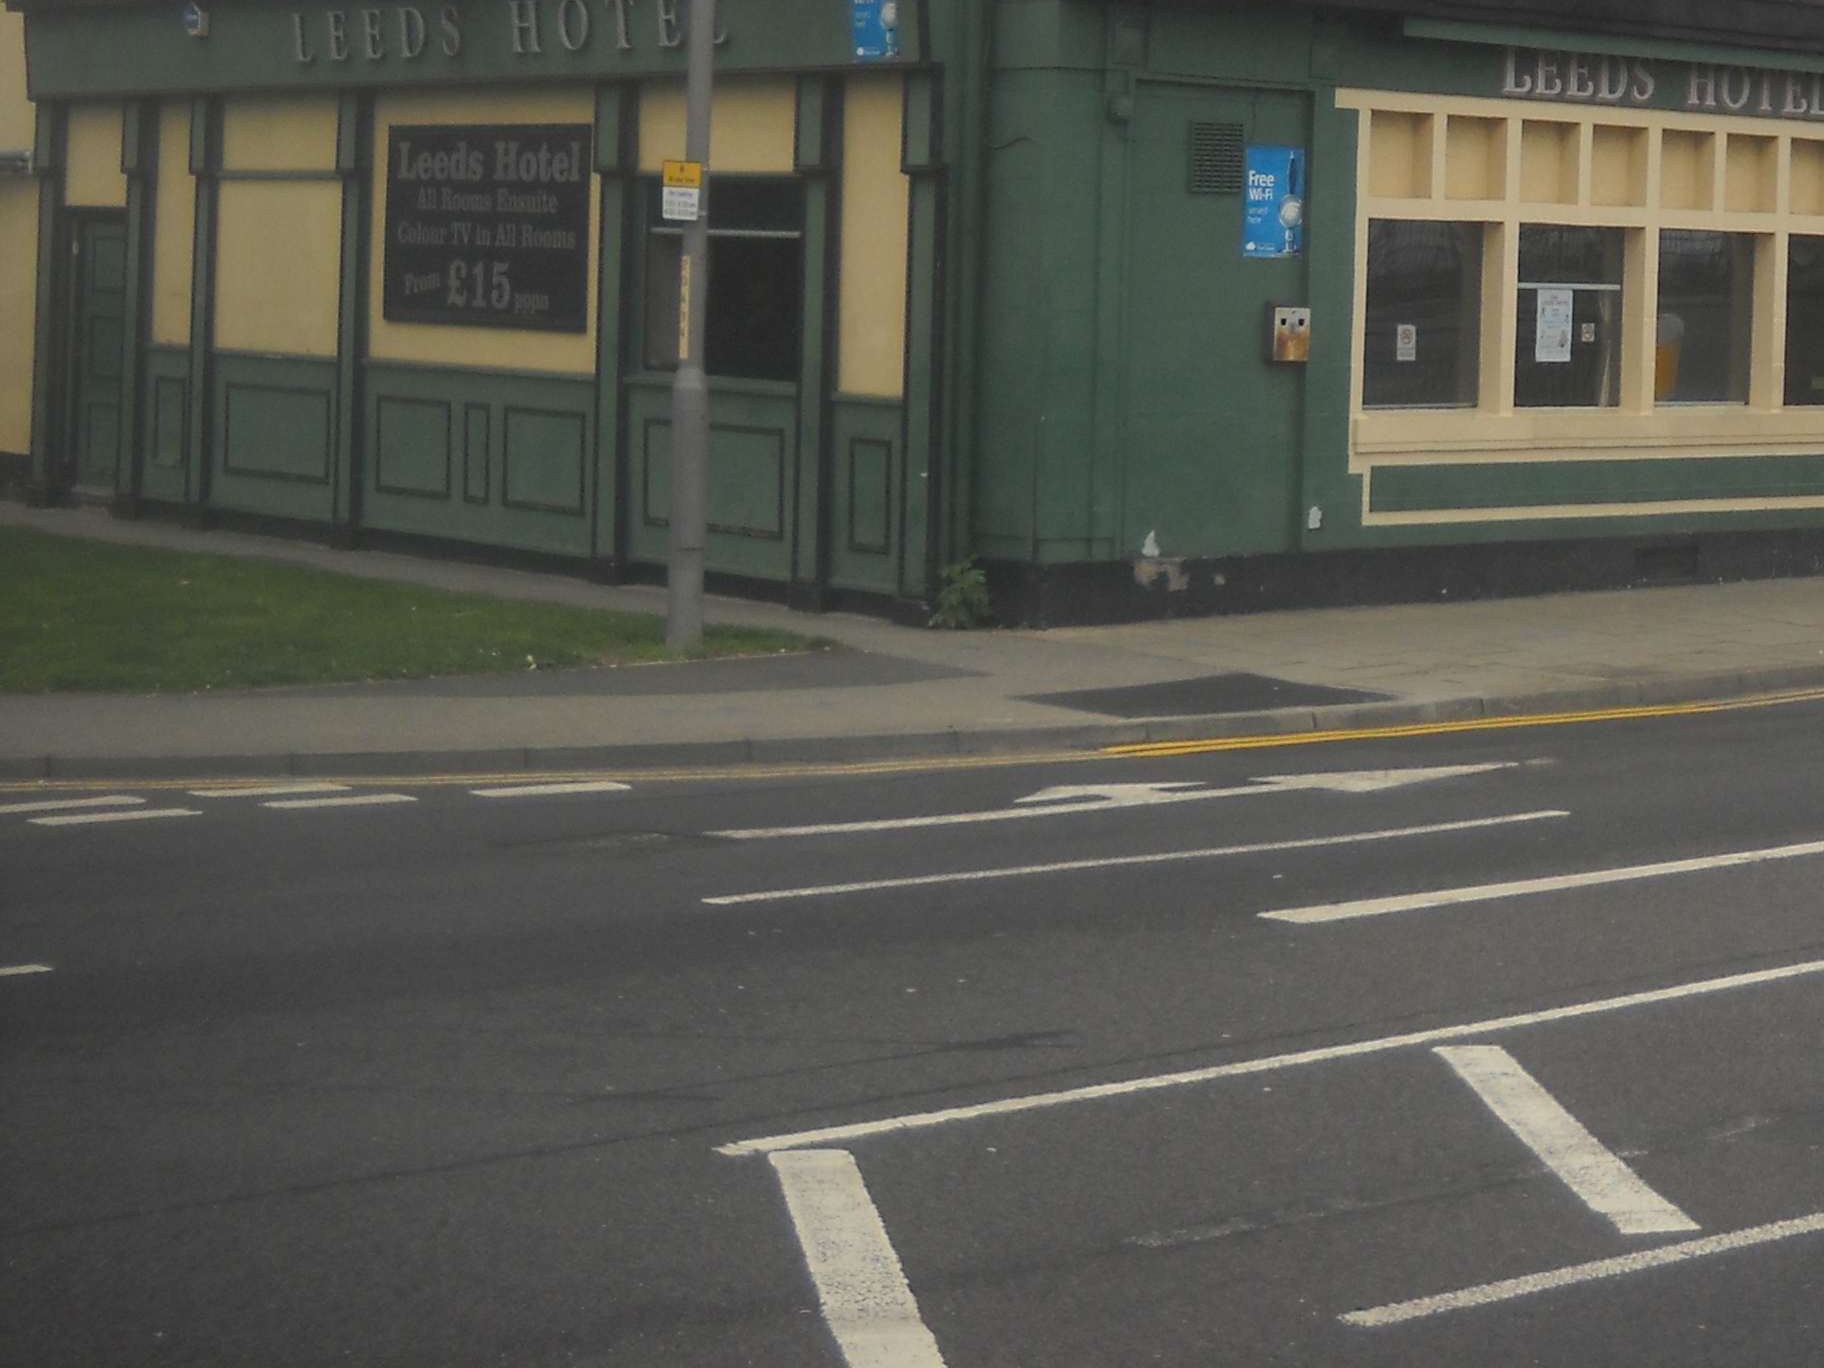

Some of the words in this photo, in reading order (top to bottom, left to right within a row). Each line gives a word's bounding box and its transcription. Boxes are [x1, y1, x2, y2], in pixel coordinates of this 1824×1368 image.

[292, 6, 462, 63] LEEDS
[1502, 45, 1657, 102] LEEDS
[398, 141, 484, 180] Leeds
[493, 141, 580, 182] Hotel
[1248, 170, 1275, 187] Free
[417, 187, 436, 210] All
[442, 187, 492, 211] Rooms
[497, 188, 558, 214] Ensuite
[1249, 187, 1273, 201] Wi-Fi
[399, 221, 446, 245] Colour
[451, 221, 472, 245] TV
[476, 223, 490, 246] in
[495, 223, 516, 247] All
[521, 224, 576, 249] Rooms
[404, 272, 440, 294] From
[448, 259, 511, 309] £15
